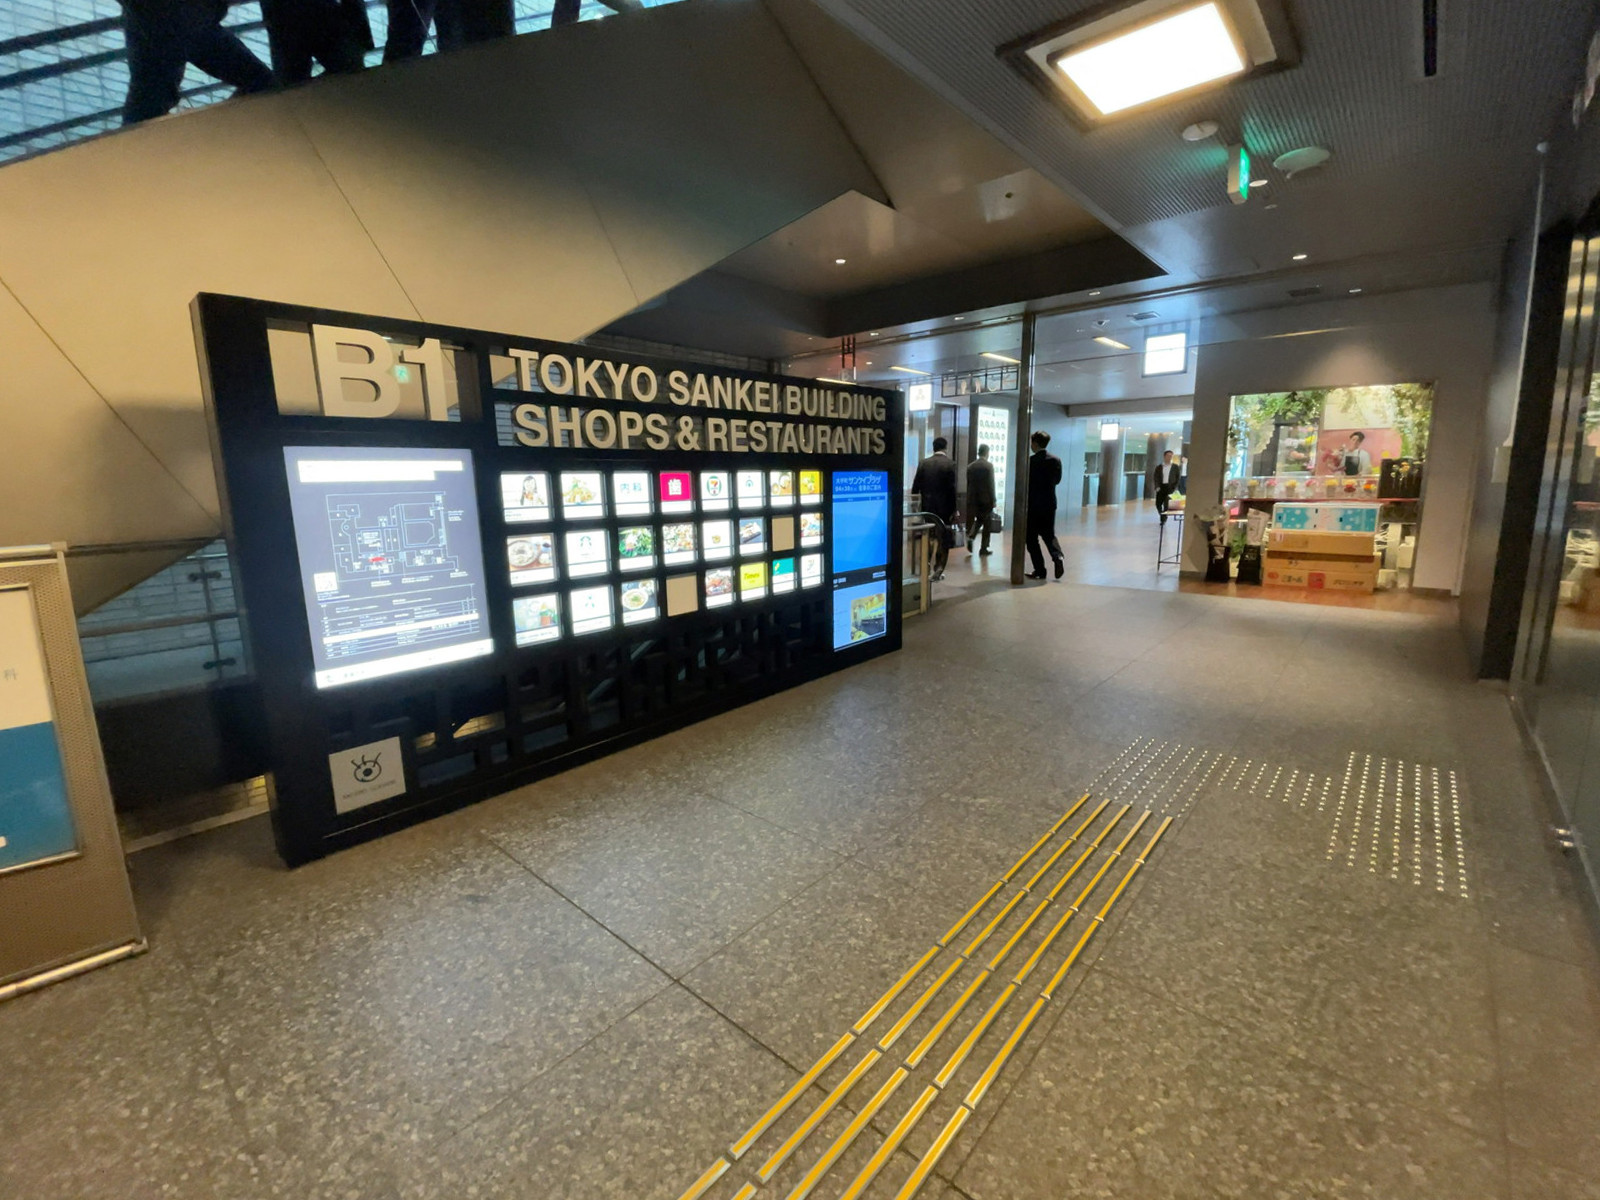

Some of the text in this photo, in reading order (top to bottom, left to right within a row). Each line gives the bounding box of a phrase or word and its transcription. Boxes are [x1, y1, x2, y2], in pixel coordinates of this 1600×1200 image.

[312, 324, 449, 421] B1
[508, 348, 887, 422] TOKYO SANKEI BUILDING
[514, 403, 886, 455] SHOPS & RESTAURANTS
